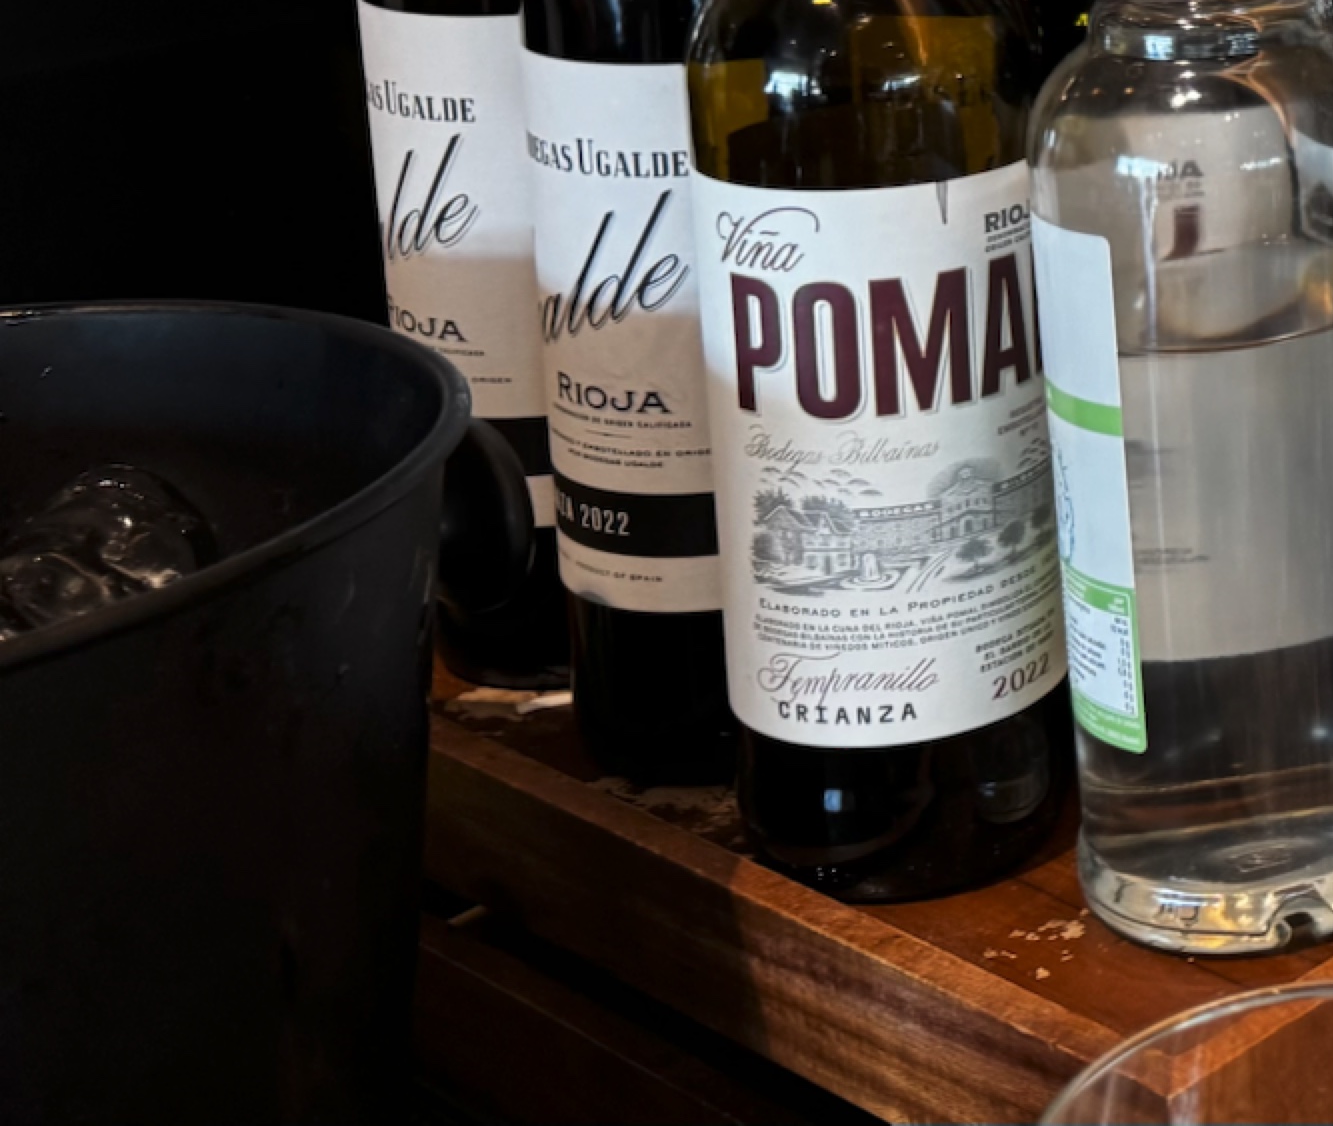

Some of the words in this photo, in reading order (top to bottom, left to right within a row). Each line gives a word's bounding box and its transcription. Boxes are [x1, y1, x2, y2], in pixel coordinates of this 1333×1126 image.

[384, 80, 477, 124] UGALDE
[576, 138, 690, 179] UGALDE
[730, 241, 1046, 423] POMA
[557, 371, 674, 415] RIOJA
[579, 503, 631, 537] 2022
[850, 607, 870, 618] EN
[880, 605, 900, 616] LA
[992, 651, 1050, 702] 2022
[778, 701, 919, 725] CRIANZA
